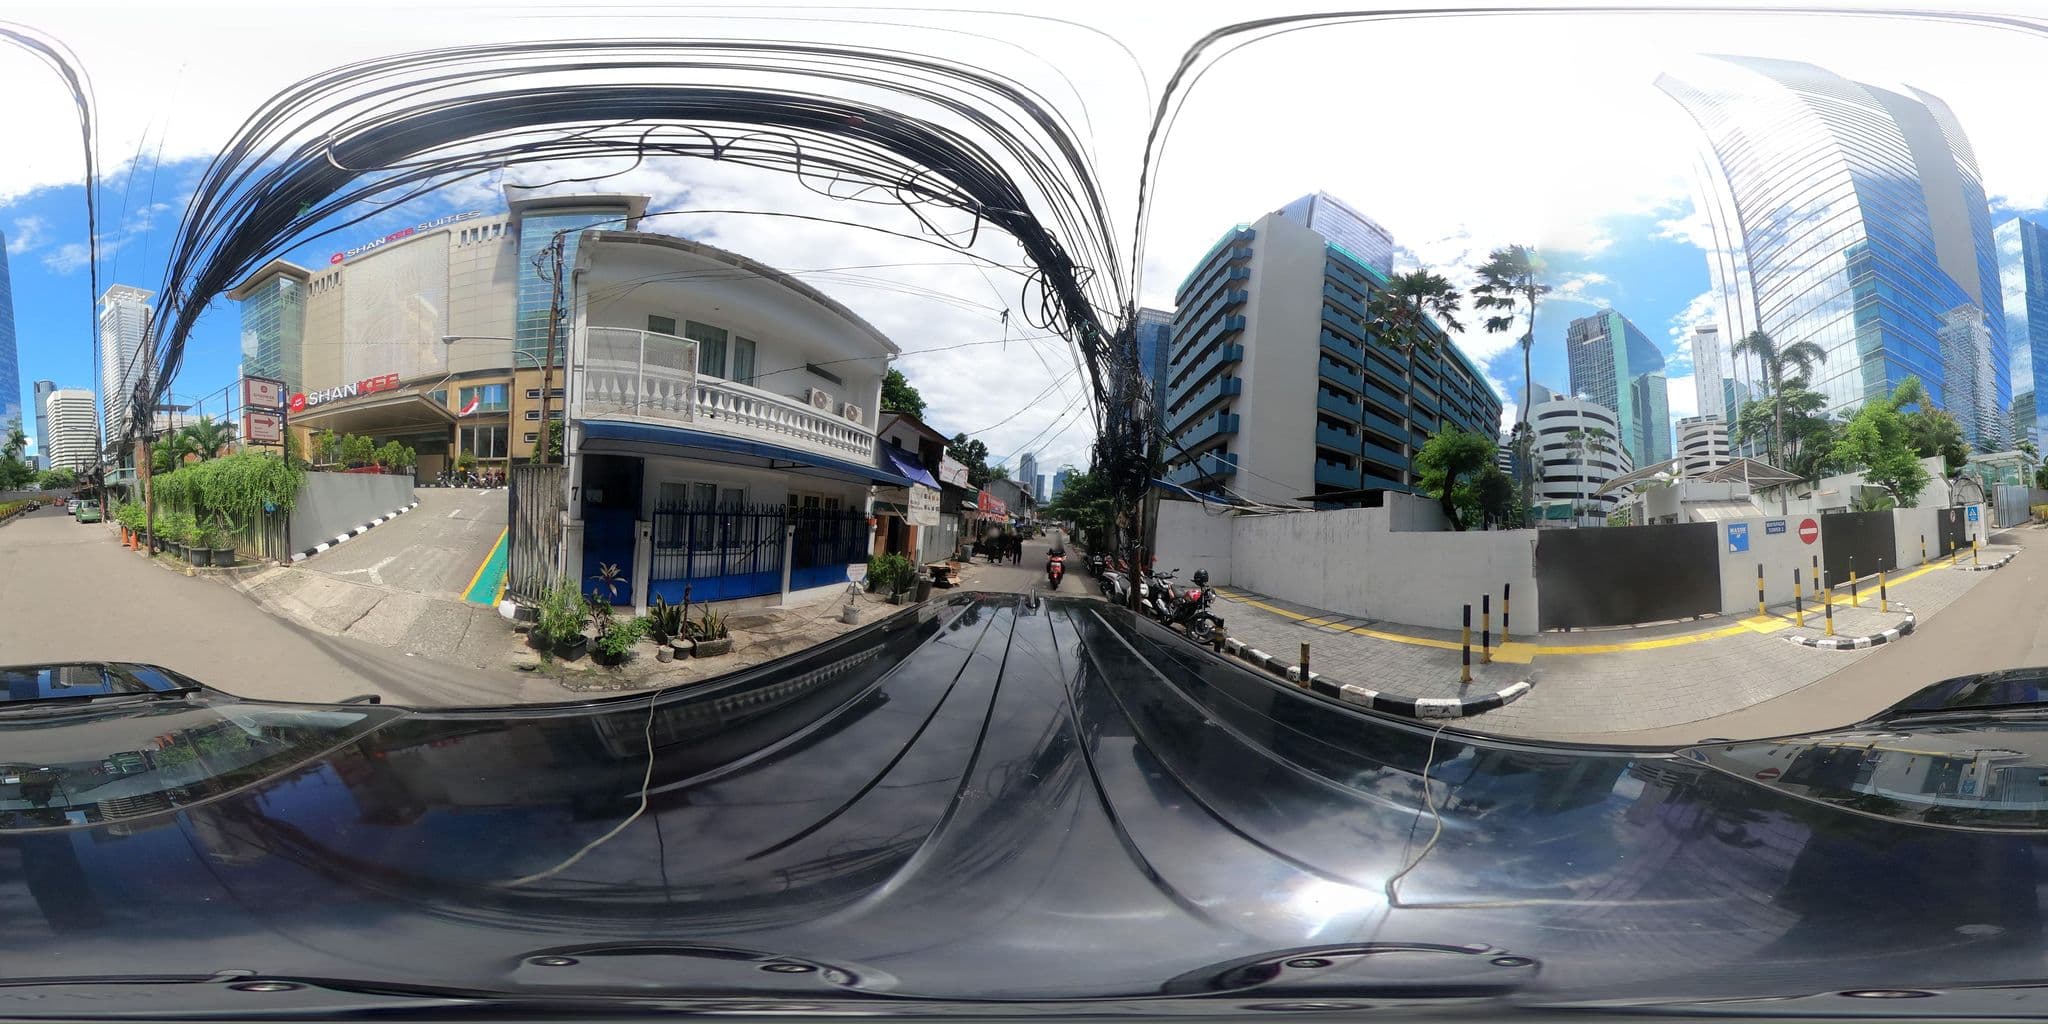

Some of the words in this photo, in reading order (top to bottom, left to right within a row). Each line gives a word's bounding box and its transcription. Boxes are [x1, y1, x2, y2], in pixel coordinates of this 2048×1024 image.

[347, 227, 415, 257] SHANKEE
[417, 211, 481, 231] SUITES
[308, 373, 399, 406] SHANKEE
[571, 486, 579, 501] 7
